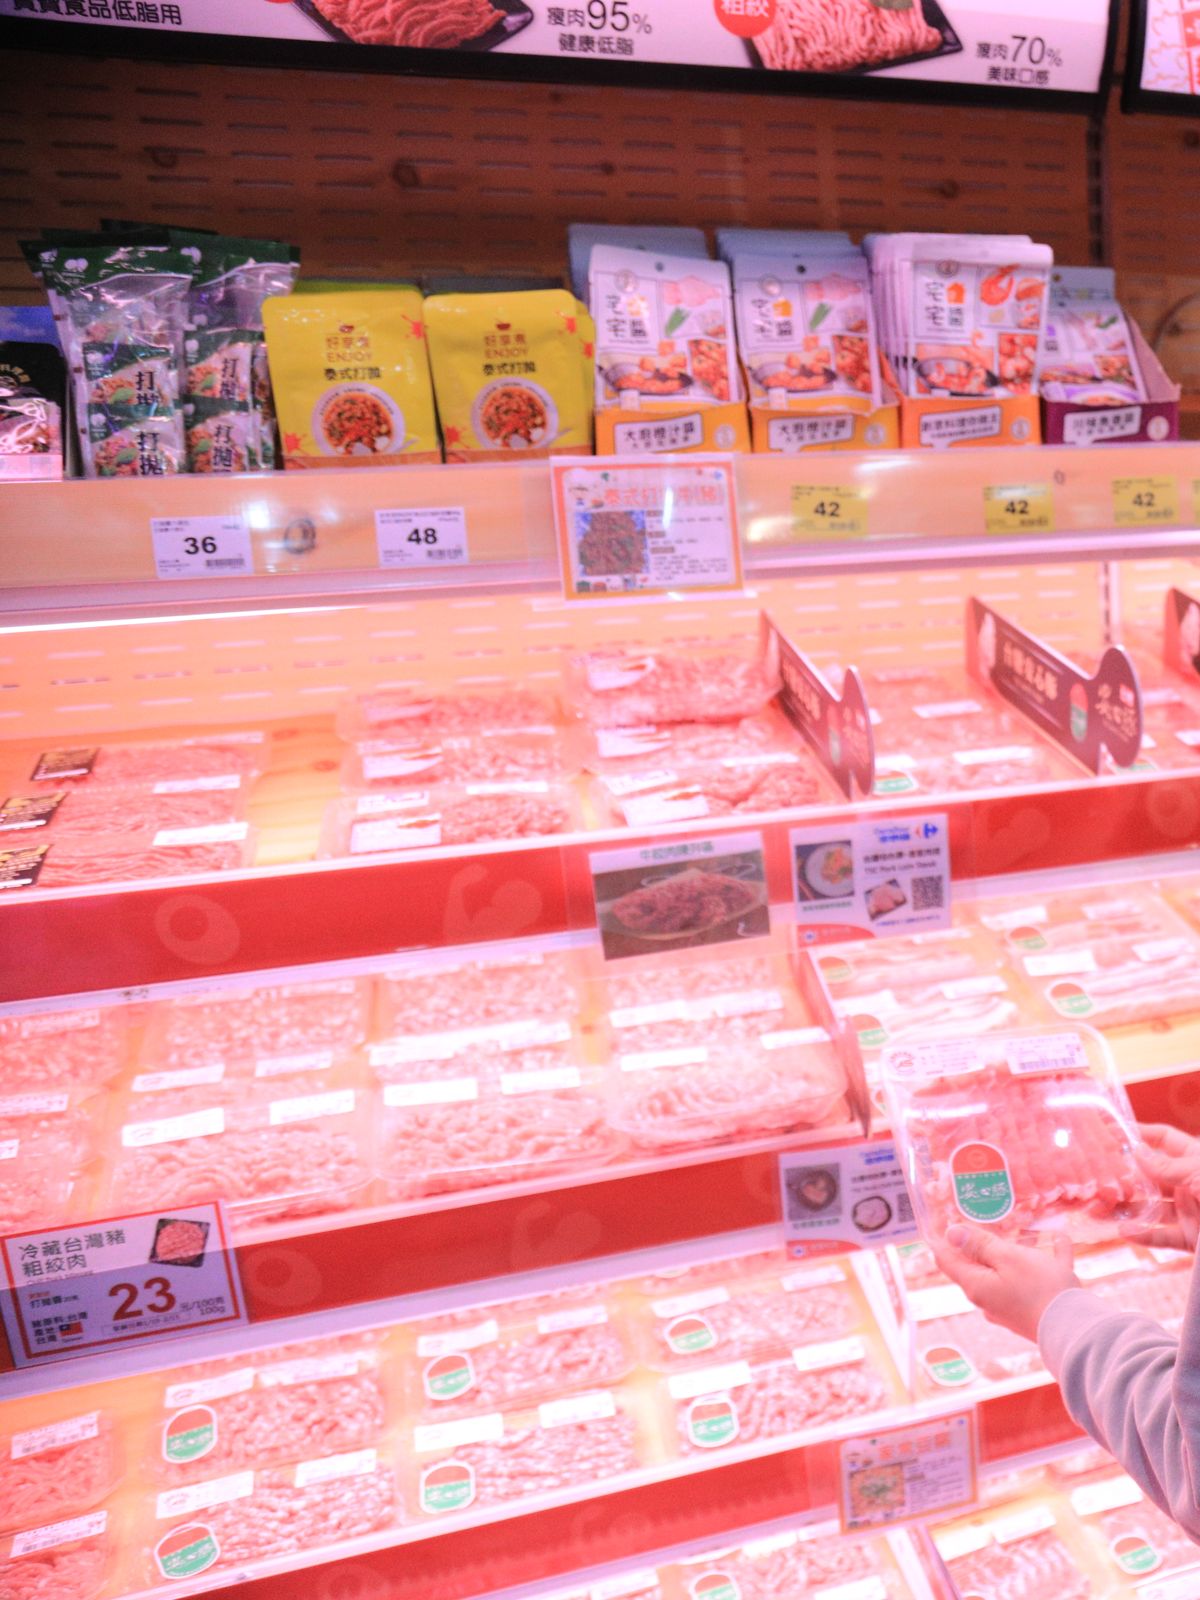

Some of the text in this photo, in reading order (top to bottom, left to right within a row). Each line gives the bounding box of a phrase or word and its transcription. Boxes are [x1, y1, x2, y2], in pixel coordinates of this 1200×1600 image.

[547, 0, 652, 34] 瘦肉95%
[559, 34, 634, 55] 健康低脂
[813, 502, 841, 518] 42
[1004, 500, 1030, 516] 42
[1132, 492, 1156, 508] 42
[184, 536, 217, 555] 36
[407, 528, 438, 545] 48
[18, 1229, 126, 1262] 冷藏台灣豬
[22, 1254, 88, 1279] 粗絞肉
[108, 1276, 177, 1322] 23
